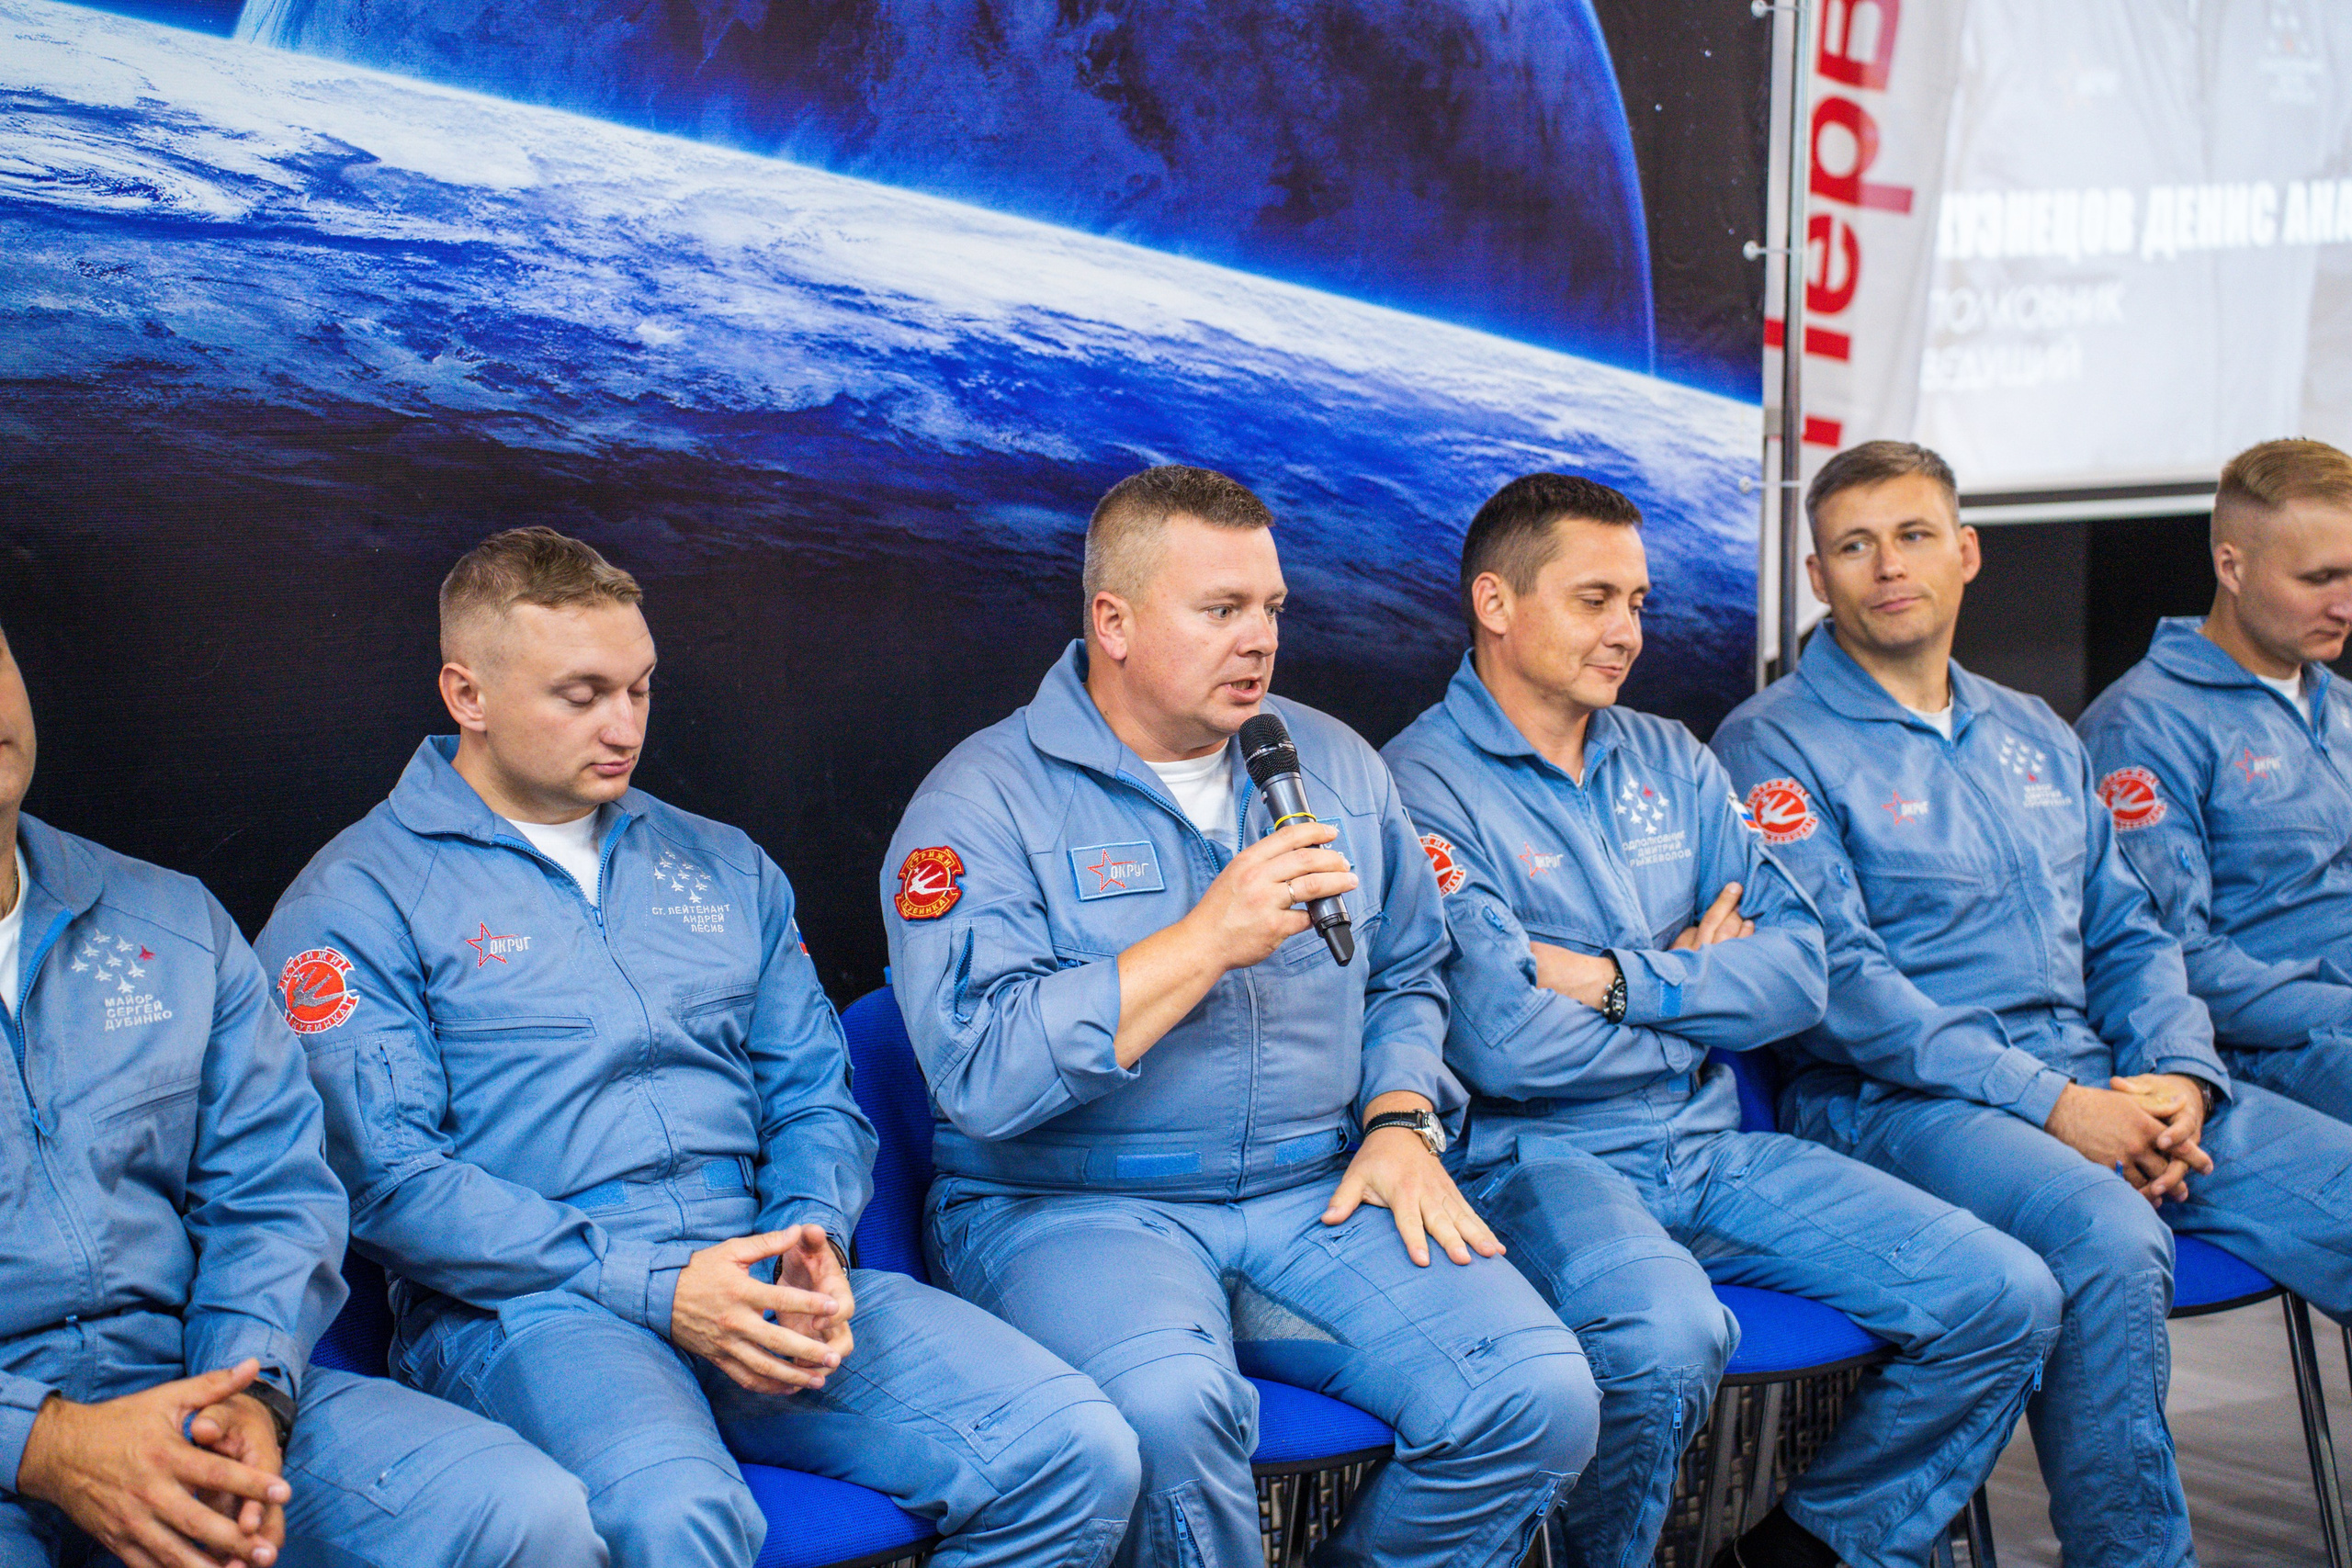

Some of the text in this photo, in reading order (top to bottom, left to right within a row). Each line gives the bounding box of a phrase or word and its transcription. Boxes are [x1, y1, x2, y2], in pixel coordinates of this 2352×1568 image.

[2142, 182, 2278, 263] ДЕНИС
[1622, 829, 1685, 852] ОДПОЛКОВНИК
[909, 851, 952, 868] СТРИЖИ
[1110, 863, 1149, 879] ОКРУГ
[651, 904, 730, 916] СТ. ЛЕЙТЕНАНТ
[903, 898, 946, 915] КУБИНКА
[683, 912, 725, 925] АНДРЕЙ
[691, 923, 724, 933] ЛЕСИВ
[490, 936, 532, 954] ОКРУГ
[283, 951, 340, 978] СТРИЖИ
[104, 994, 153, 1008] МАЙОР
[107, 999, 164, 1019] СЕРГЕЙ
[104, 1010, 173, 1032] ДУБИНКО
[291, 1008, 348, 1032] КУБИНКА
